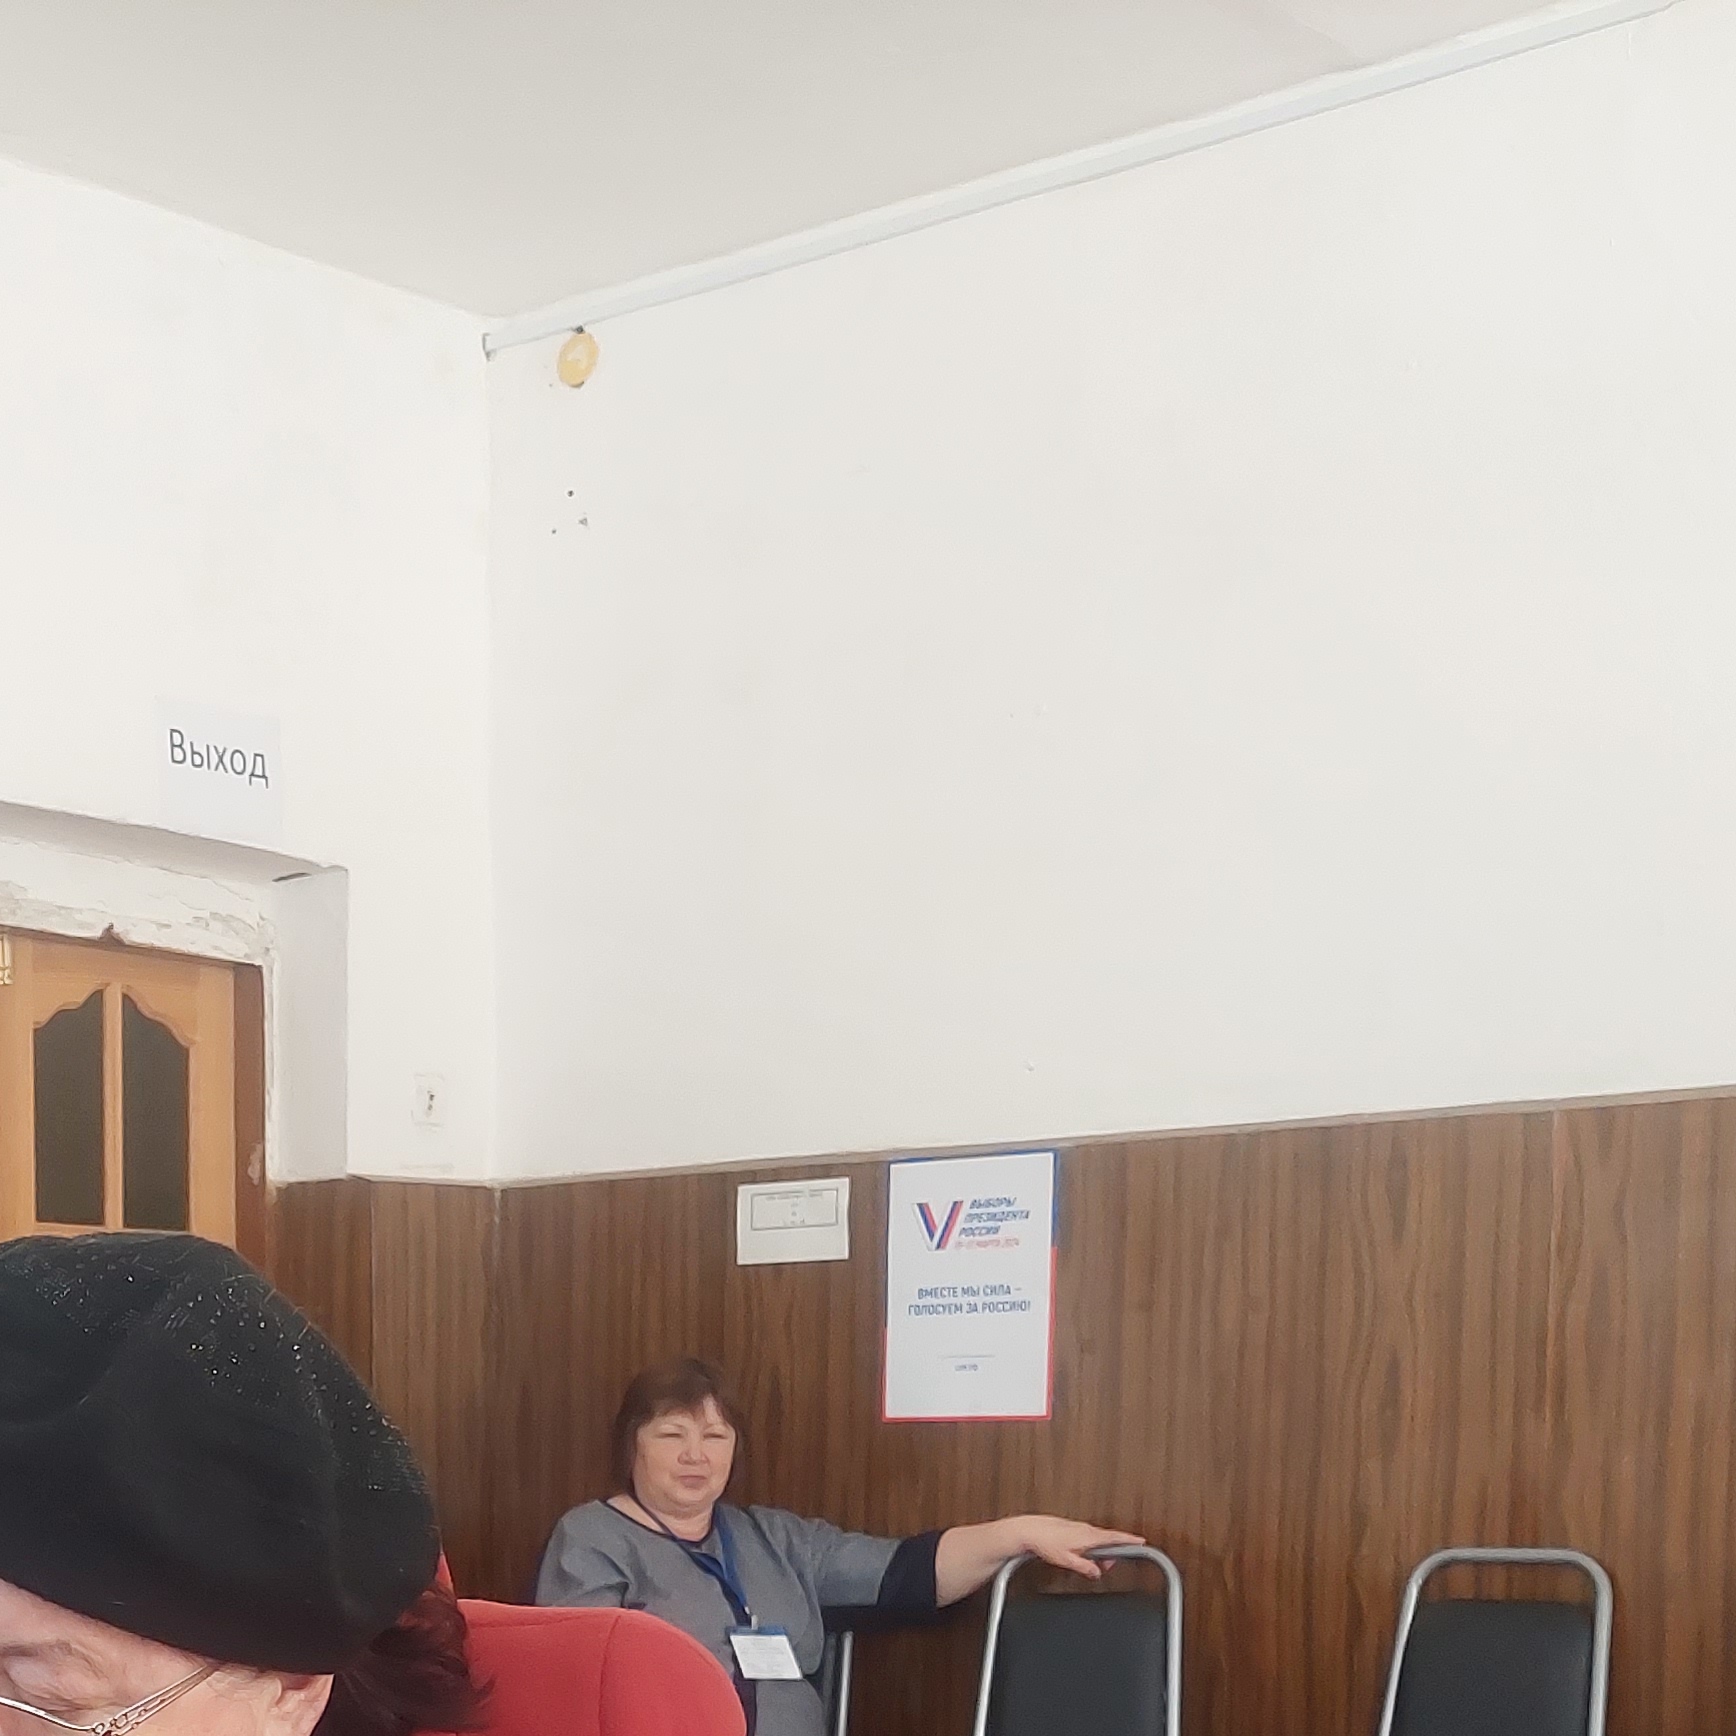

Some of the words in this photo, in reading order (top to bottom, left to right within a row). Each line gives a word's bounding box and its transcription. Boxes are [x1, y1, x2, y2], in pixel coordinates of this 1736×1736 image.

[169, 728, 269, 790] Выход
[917, 1287, 959, 1301] ВМЕСТЕ
[961, 1286, 980, 1299] МЫ
[982, 1284, 1012, 1297] СИЛА
[907, 1302, 963, 1317] ГОЛОСУЕМ
[965, 1301, 980, 1314] ЗА
[981, 1300, 1031, 1314] РОССИЮ!
